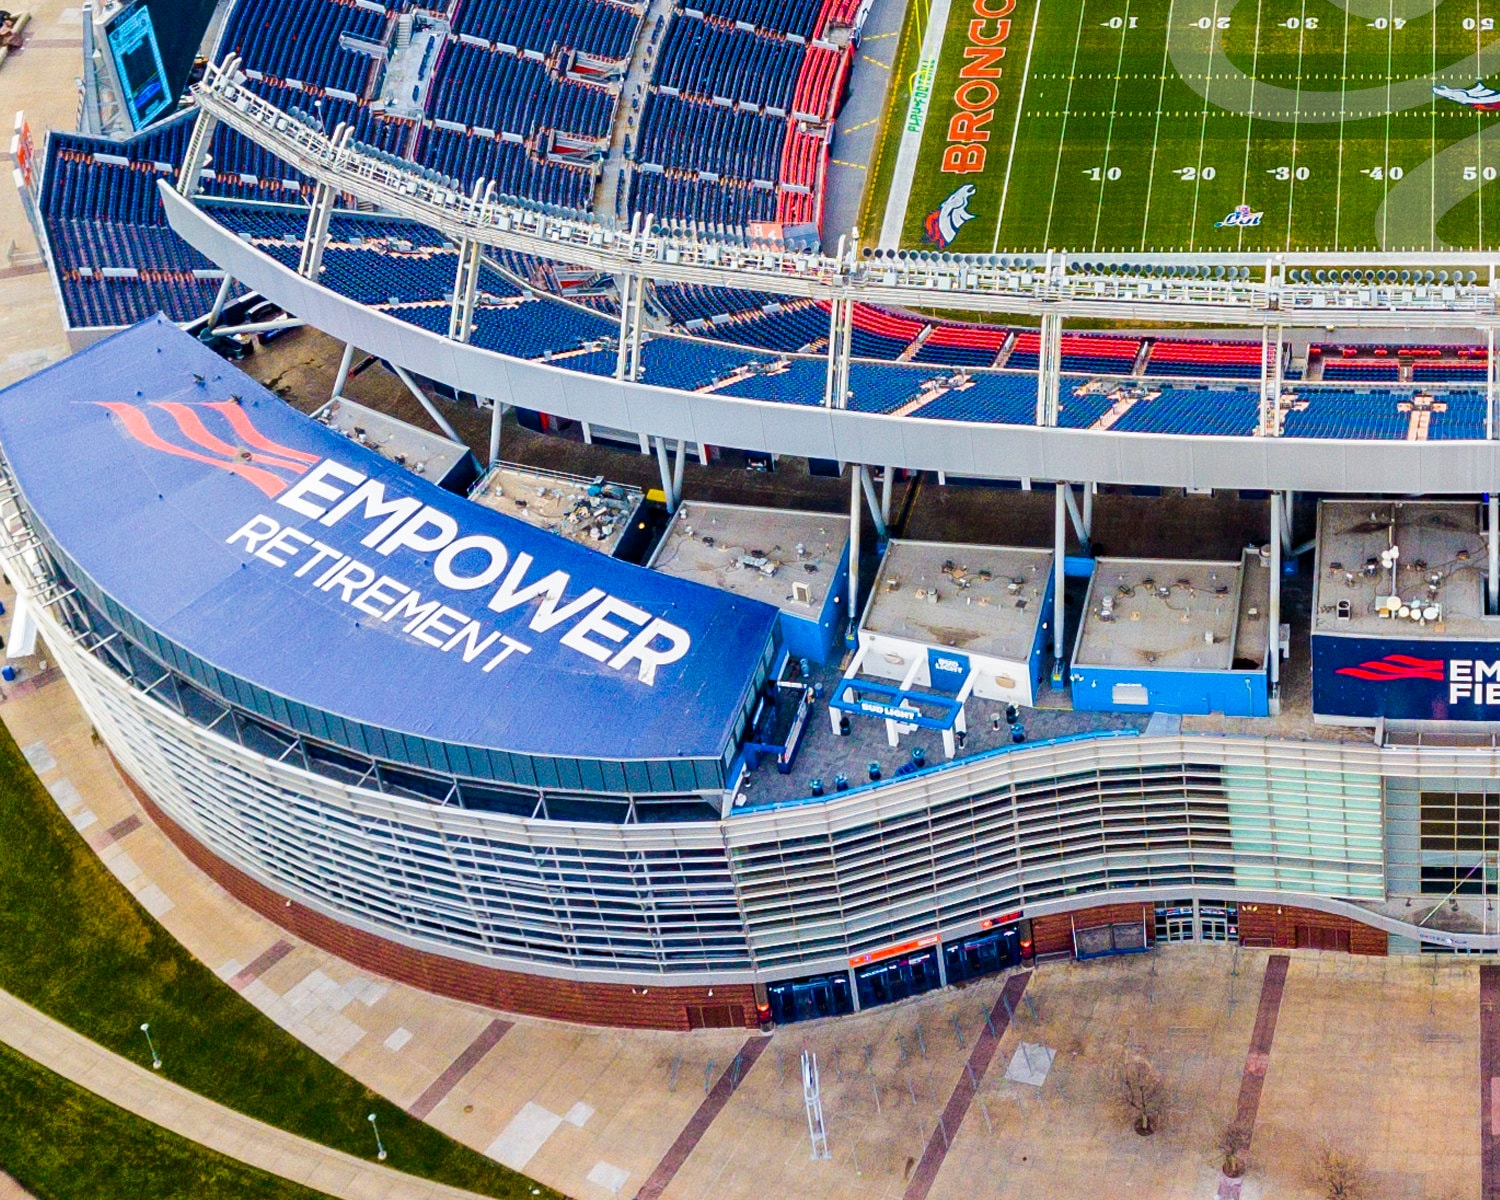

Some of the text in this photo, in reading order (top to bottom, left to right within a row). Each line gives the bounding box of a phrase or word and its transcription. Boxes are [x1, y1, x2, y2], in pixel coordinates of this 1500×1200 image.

[1109, 17, 1139, 30] 10
[1198, 17, 1231, 30] 20
[1286, 17, 1319, 30] 30
[1374, 17, 1407, 30] 40
[1462, 17, 1494, 30] 50
[1090, 166, 1122, 181] 10
[1181, 166, 1216, 181] 20
[1275, 166, 1310, 181] 30
[1369, 166, 1404, 181] 40
[1462, 166, 1497, 181] 50
[275, 458, 692, 687] EMPOWER
[223, 513, 533, 673] RETIREMENT
[861, 702, 916, 721] BUD LIGHT
